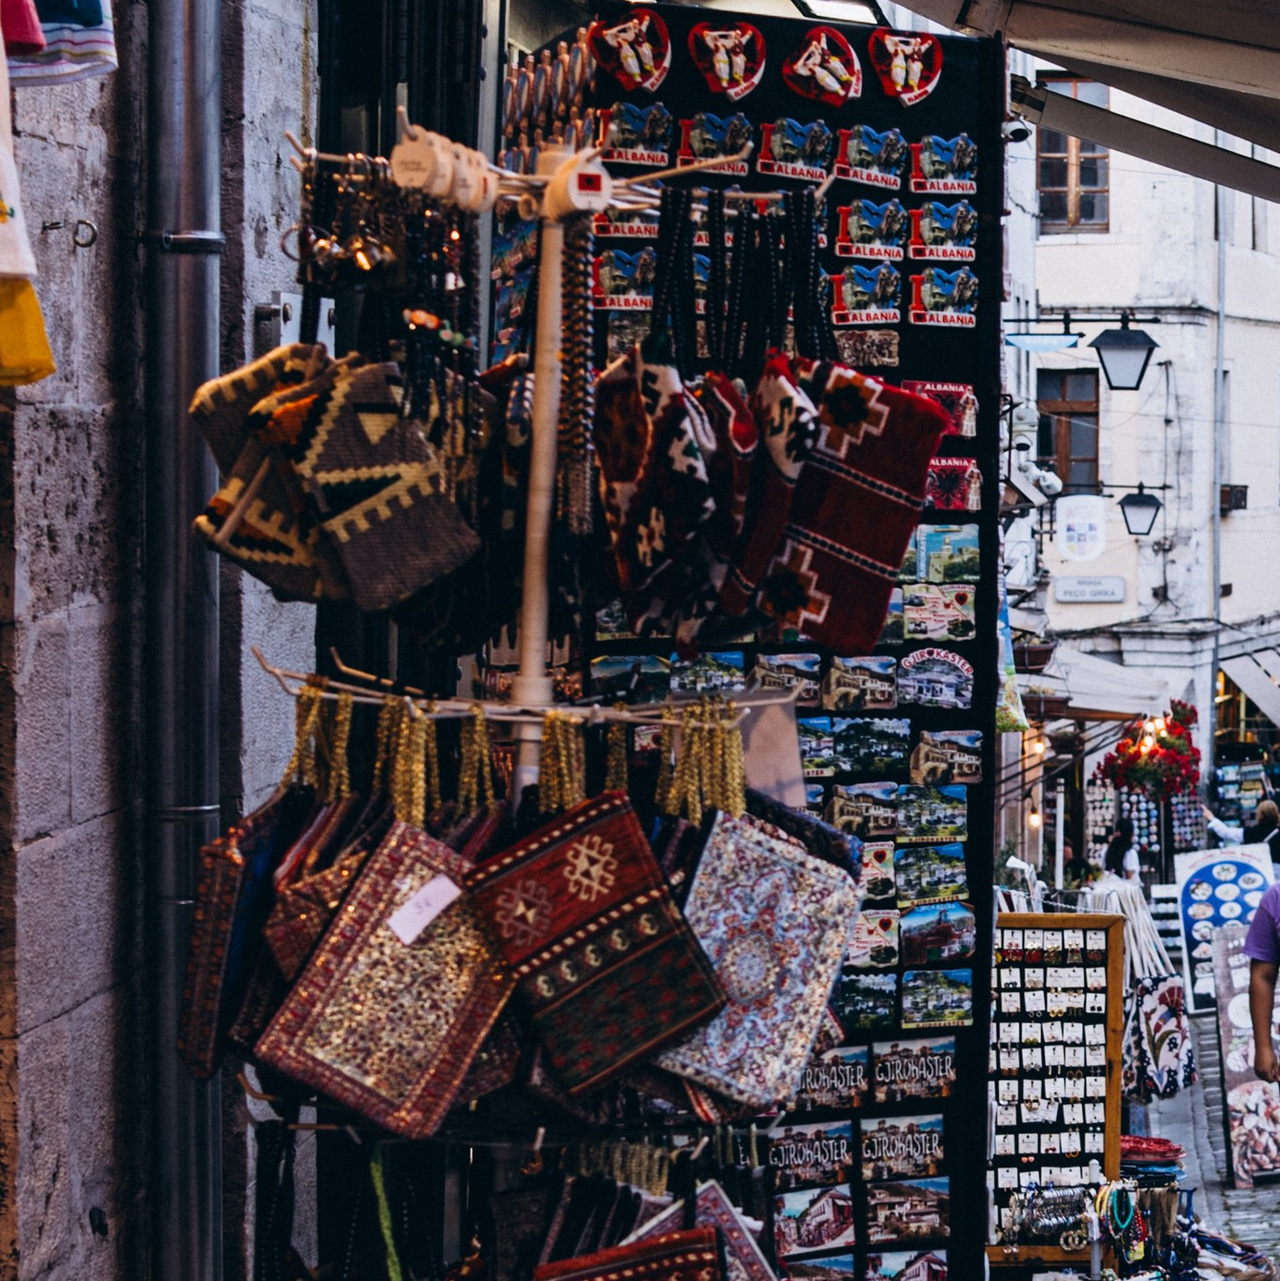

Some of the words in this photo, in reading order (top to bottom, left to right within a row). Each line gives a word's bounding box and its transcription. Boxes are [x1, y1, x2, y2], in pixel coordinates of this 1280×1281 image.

[616, 148, 668, 165] ALBANIA
[776, 165, 826, 181] ALBANIA
[852, 169, 899, 188] ALBANIA
[927, 181, 976, 193] ALBANIA
[855, 245, 903, 259] ALBANIA
[927, 247, 975, 259] ALBANIA
[608, 296, 653, 309] ALBANI
[851, 310, 900, 323] ALBANIA
[928, 313, 975, 326] ALBANIA
[925, 383, 965, 393] ALBANIA
[929, 458, 969, 467] ALBANIA
